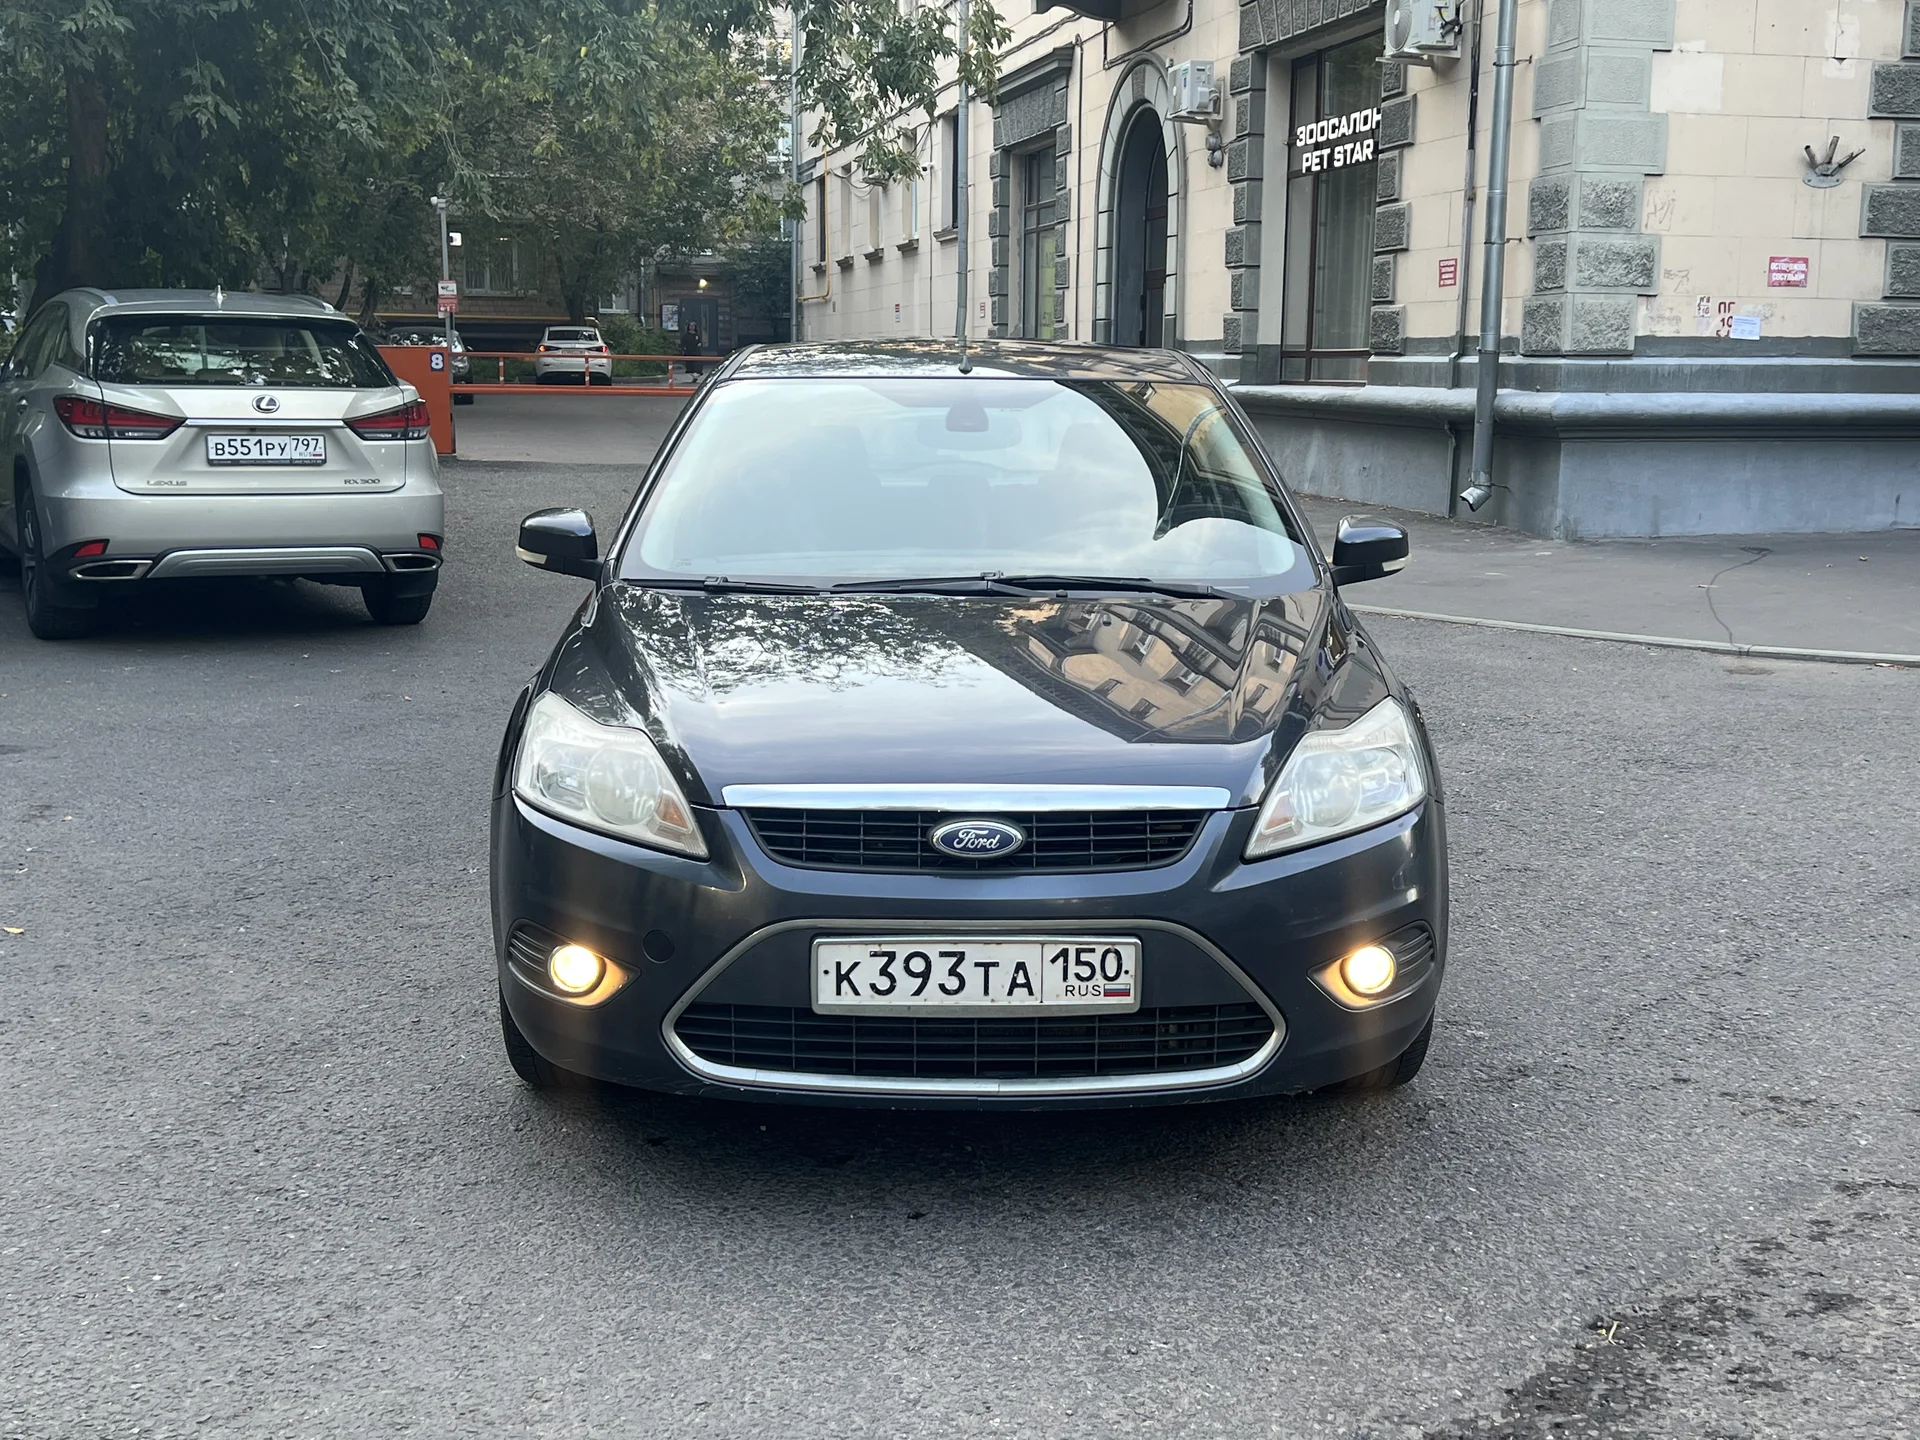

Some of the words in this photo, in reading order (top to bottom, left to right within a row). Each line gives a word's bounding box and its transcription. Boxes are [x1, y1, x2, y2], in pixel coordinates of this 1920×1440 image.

[1296, 107, 1382, 147] ЗООСАЛОН
[1302, 148, 1331, 174] PET
[1333, 139, 1374, 168] STAR
[431, 353, 444, 370] 8
[215, 438, 288, 457] В551РУ
[291, 438, 319, 452] 797
[953, 828, 1001, 849] Ford
[835, 950, 1035, 997] К393ТА
[1049, 947, 1123, 983] 150
[1065, 984, 1101, 997] RUS
